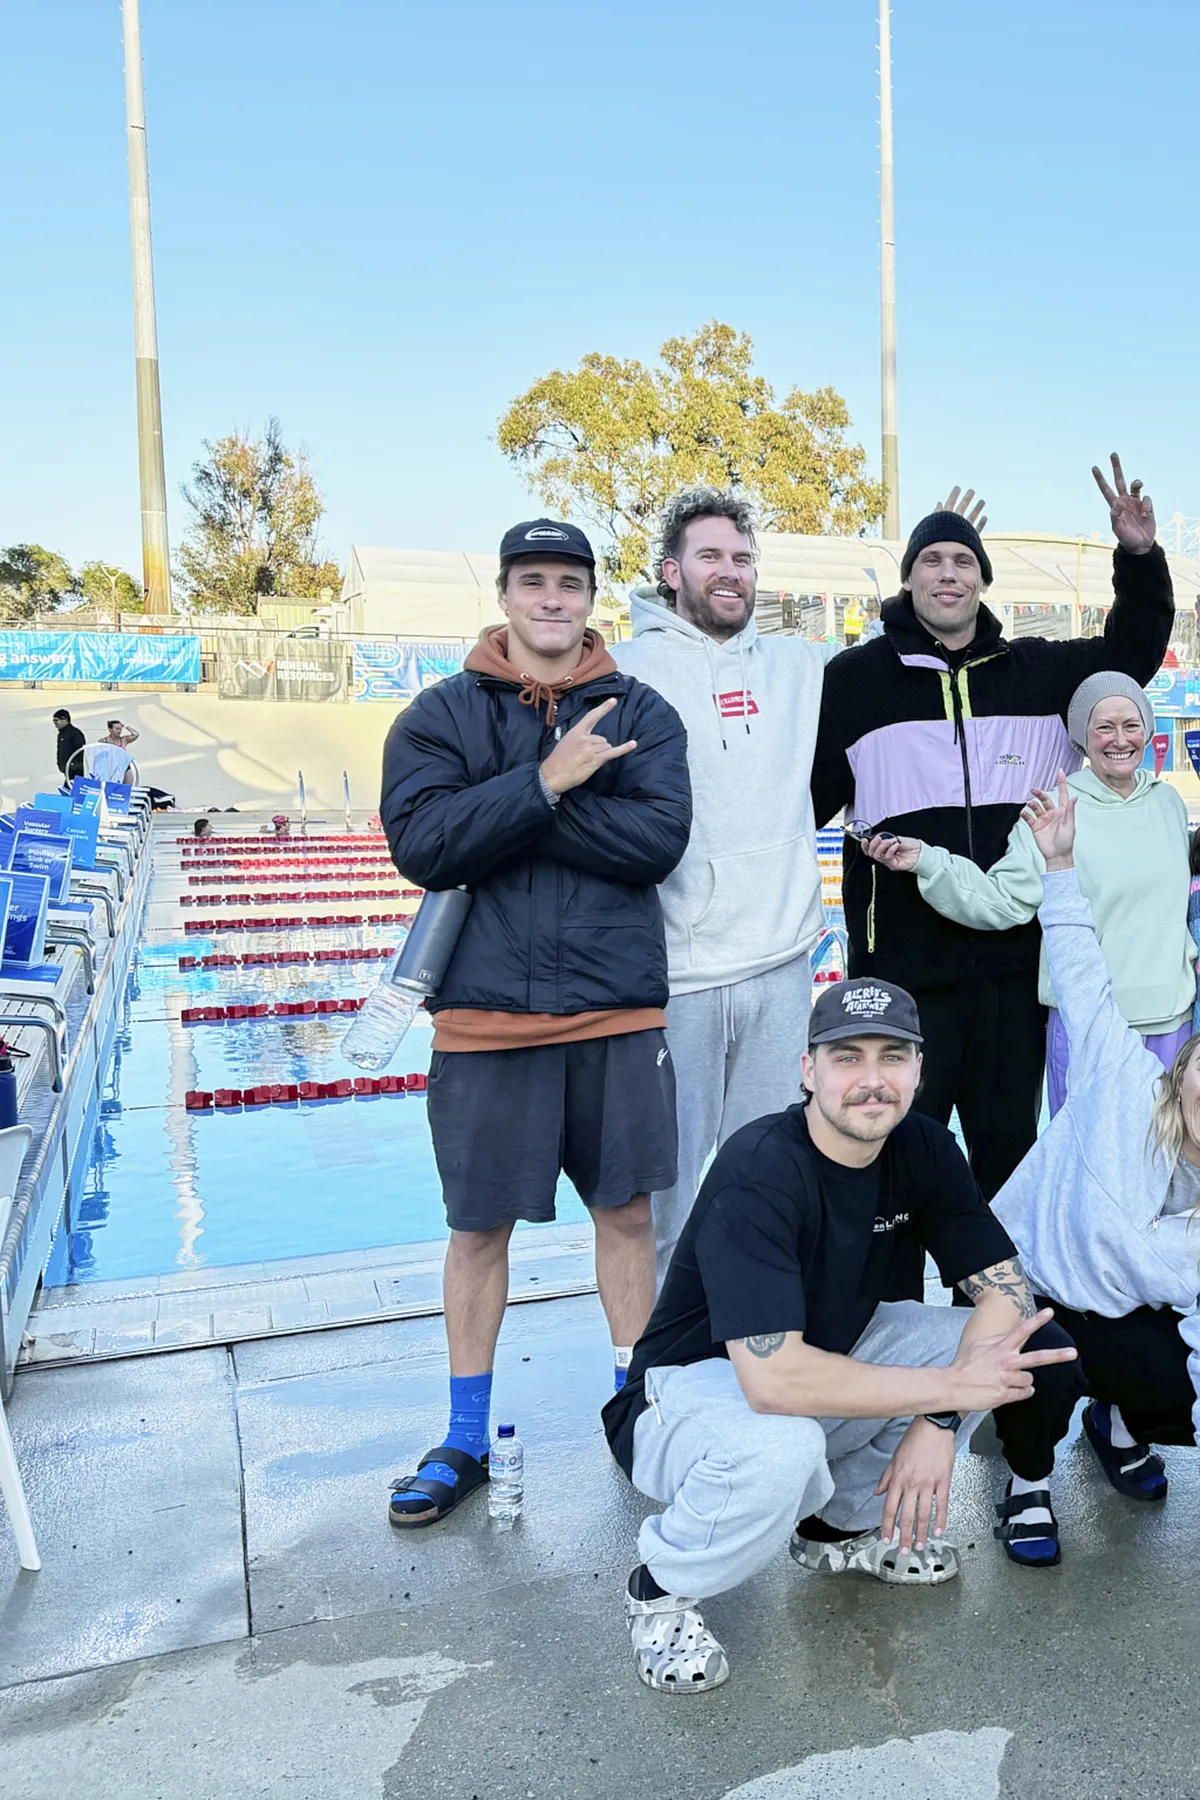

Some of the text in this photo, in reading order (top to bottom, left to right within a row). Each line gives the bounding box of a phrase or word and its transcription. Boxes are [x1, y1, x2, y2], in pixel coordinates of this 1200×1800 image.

[10, 651, 76, 665] answers
[276, 659, 321, 672] MINERAL
[276, 669, 335, 682] RESOURCES
[28, 861, 50, 871] Swim
